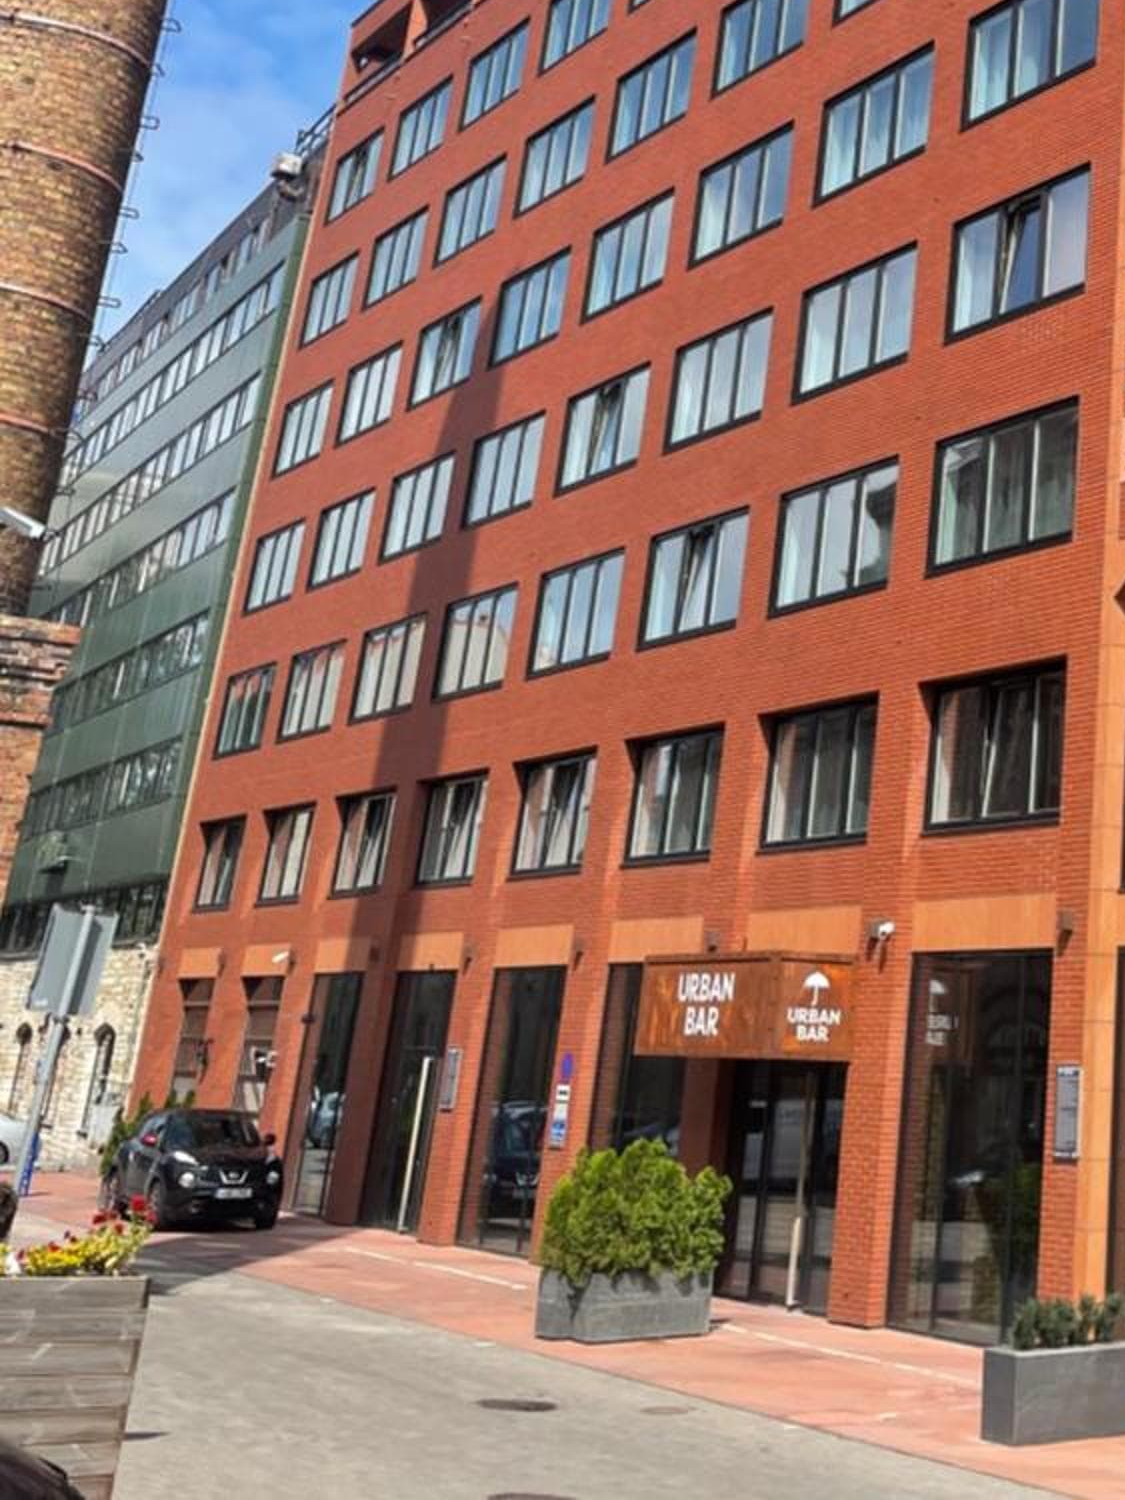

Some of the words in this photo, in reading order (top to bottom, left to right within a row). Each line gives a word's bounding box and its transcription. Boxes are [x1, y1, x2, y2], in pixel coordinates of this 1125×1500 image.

[677, 972, 736, 1002] URBAN
[683, 1006, 719, 1037] BAR
[786, 1007, 842, 1025] URBAN
[795, 1025, 829, 1042] BAR
